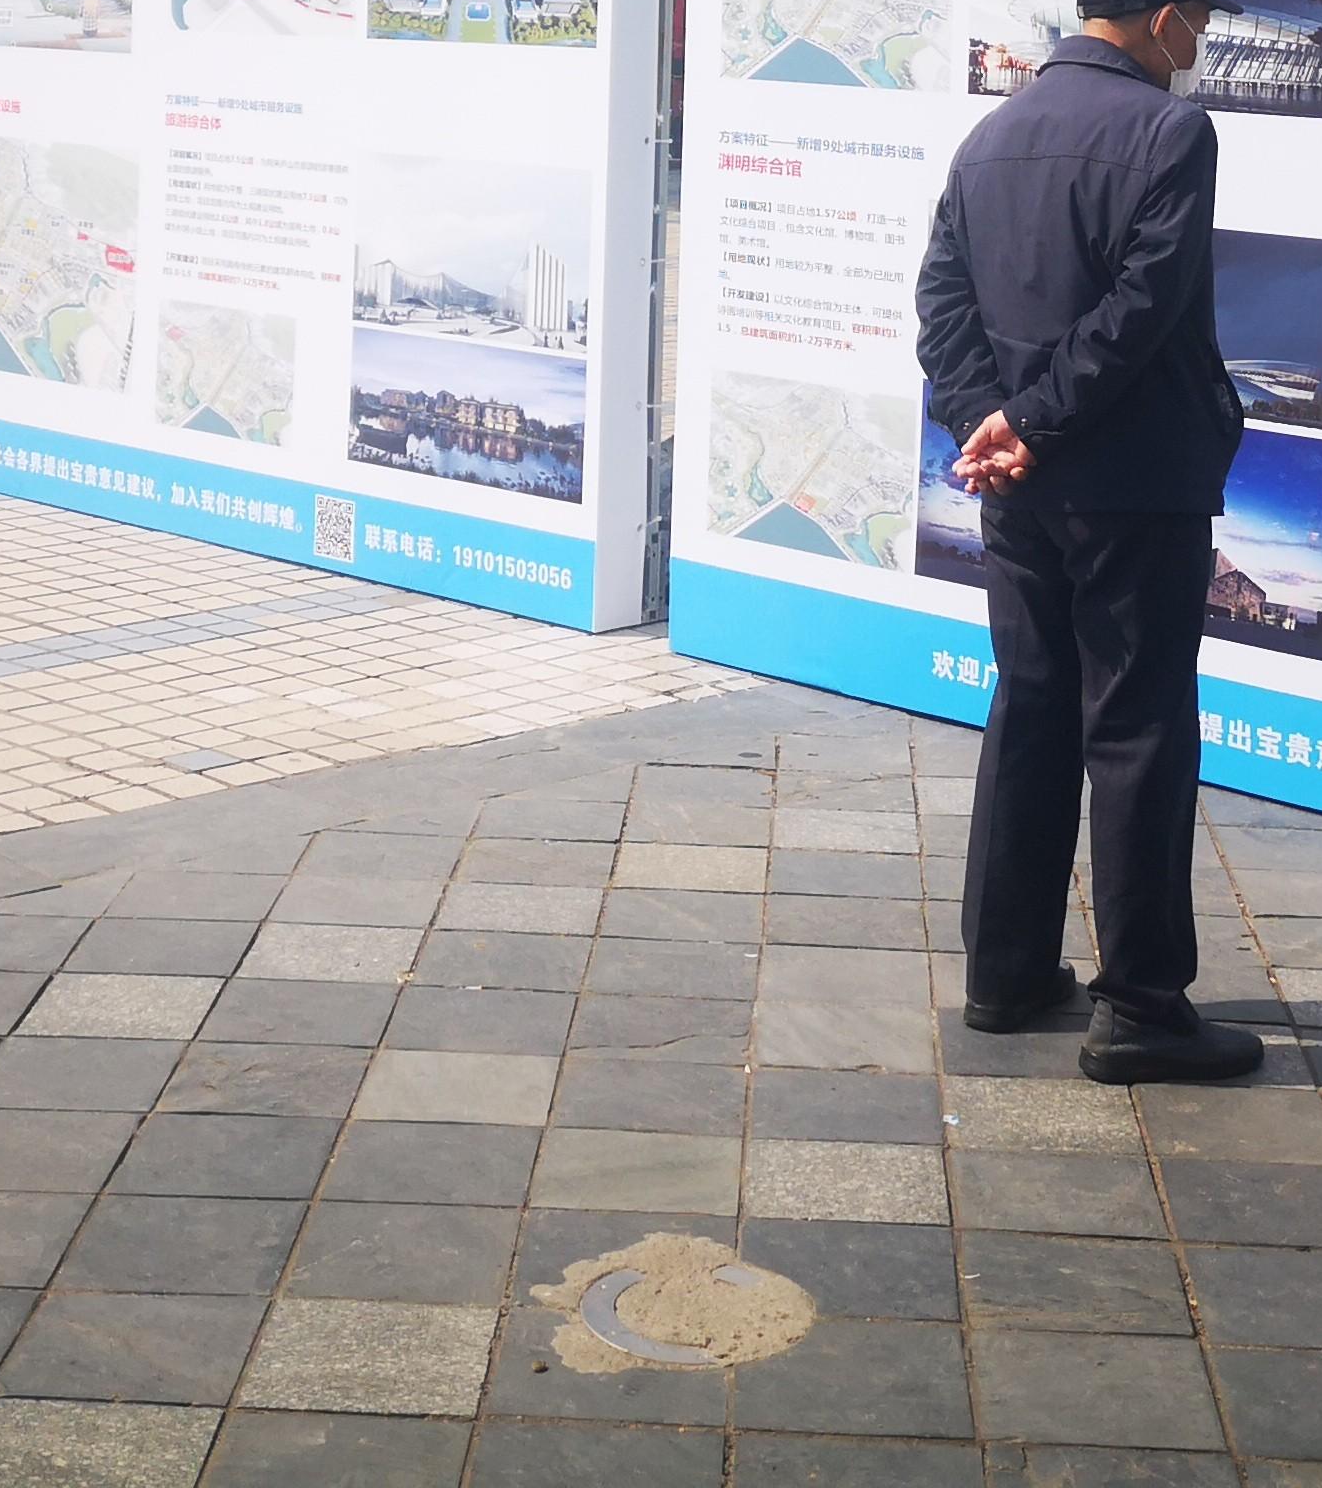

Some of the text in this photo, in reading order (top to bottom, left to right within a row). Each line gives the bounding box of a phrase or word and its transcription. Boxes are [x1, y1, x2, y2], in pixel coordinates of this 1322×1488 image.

[717, 130, 926, 161] 方案特征——新增9处城市服务设施
[717, 152, 803, 178] 渊明综合馆
